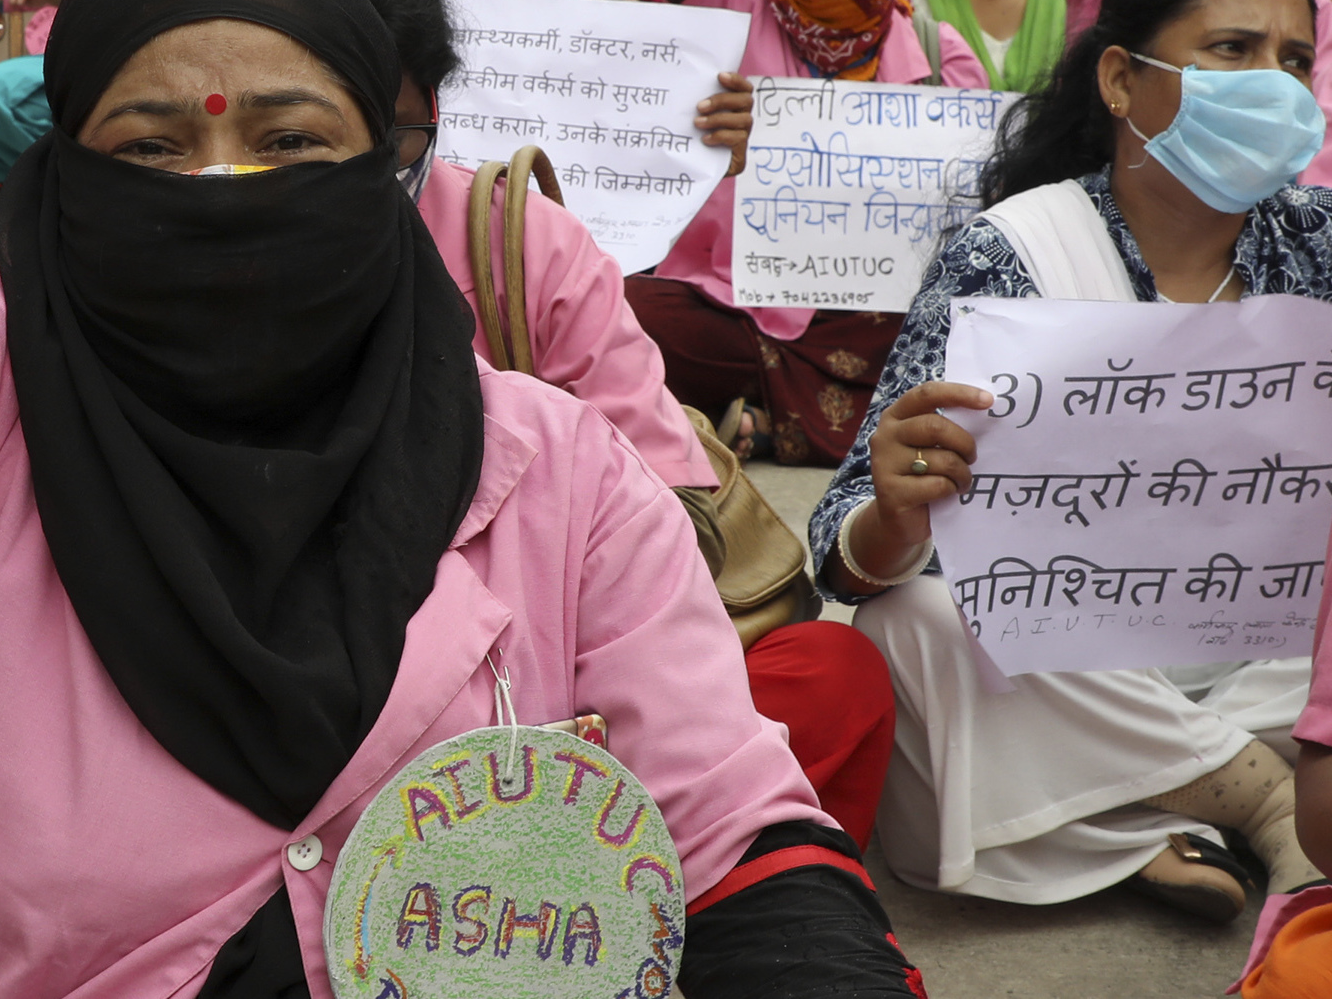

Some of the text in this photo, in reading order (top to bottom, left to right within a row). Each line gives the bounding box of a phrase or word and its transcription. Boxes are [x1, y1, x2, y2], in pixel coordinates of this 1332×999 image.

[569, 30, 635, 61] डॉक्टर,
[642, 38, 682, 66] नर्स,
[522, 70, 576, 97] वर्कर्स
[580, 77, 607, 99] को
[612, 84, 669, 112] सुरक्षा
[841, 91, 922, 129] आशा
[439, 110, 489, 133] लब्ध
[557, 121, 609, 146] उनके
[612, 123, 693, 153] संक्रमित
[562, 164, 694, 197] की जिम्मेवारी
[798, 255, 895, 279] AIUTUC
[1063, 358, 1175, 416] लॉक
[1181, 361, 1306, 412] डाउन
[959, 452, 1332, 528] मज़दूरों की नौक
[1185, 552, 1253, 603] की
[1260, 561, 1324, 600] जा
[400, 745, 676, 895] AIUTUC
[396, 881, 607, 967] ASHA
